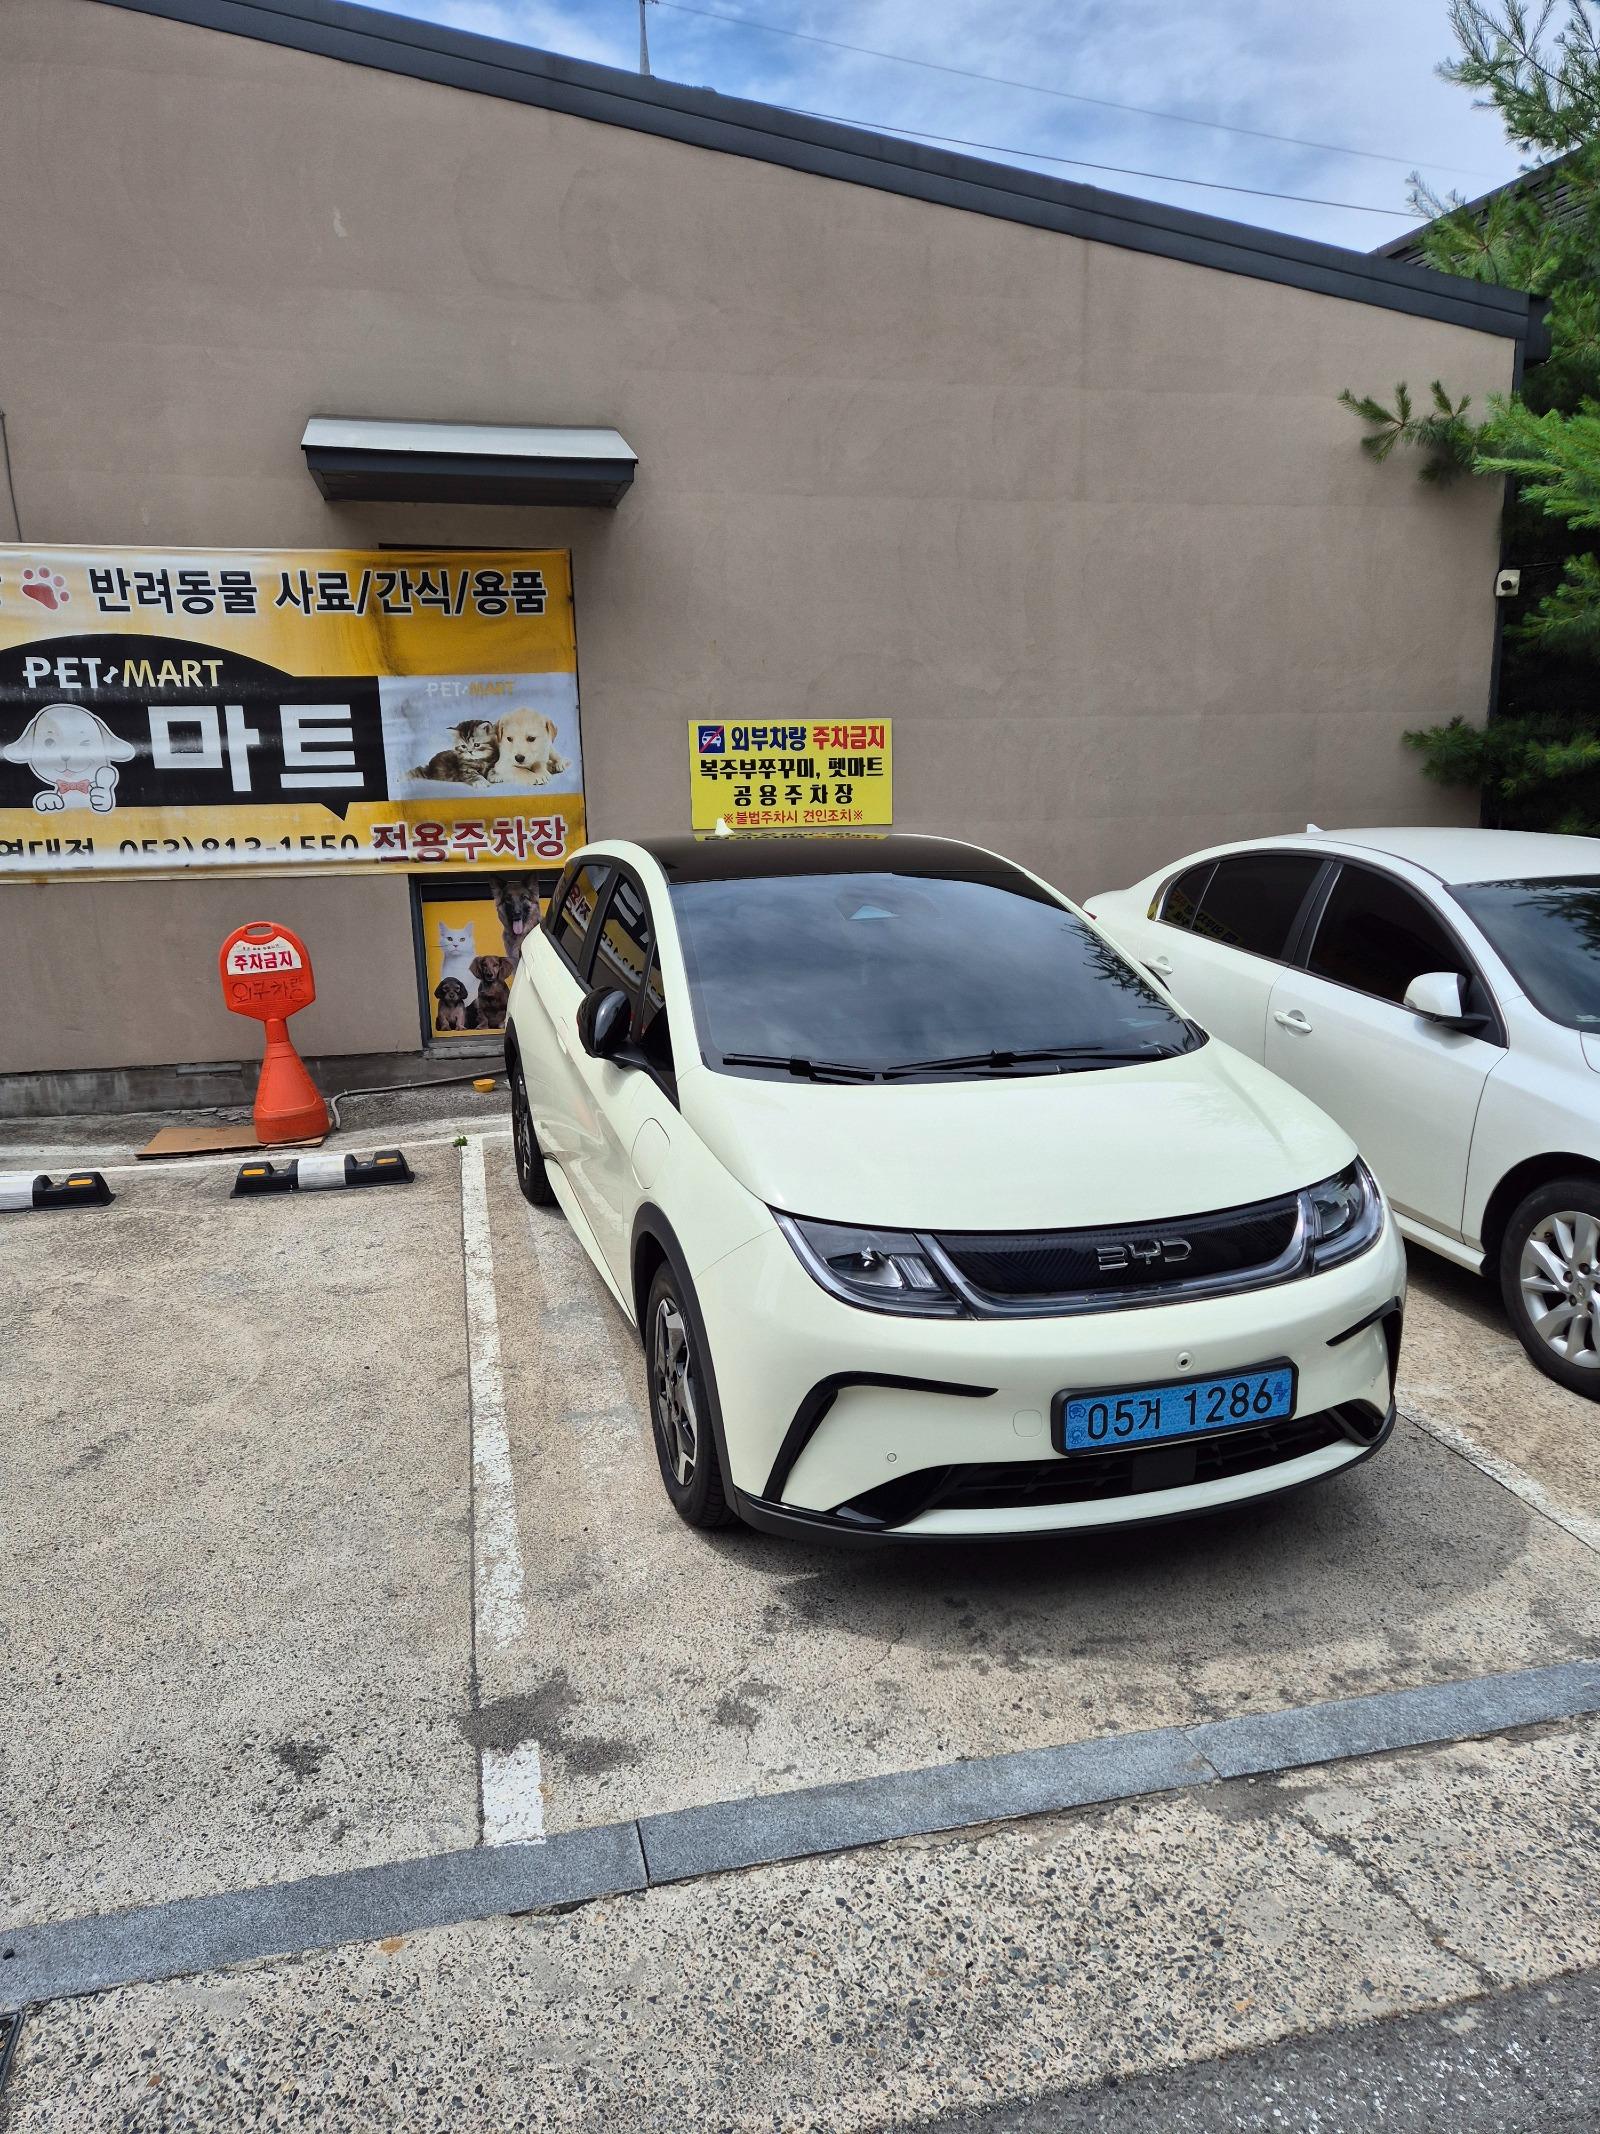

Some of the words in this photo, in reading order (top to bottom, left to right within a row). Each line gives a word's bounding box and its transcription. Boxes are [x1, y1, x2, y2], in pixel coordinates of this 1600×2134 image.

[88, 567, 259, 615] 반려동물
[274, 569, 548, 616] 사료/간식/용품
[22, 656, 101, 689] PET
[122, 659, 224, 688] MART
[147, 704, 365, 792] 마트
[731, 726, 807, 752] 외부차량
[812, 725, 885, 750] 주차금지
[828, 756, 884, 778] 펫마트
[372, 816, 566, 862] 전용주차장
[234, 950, 293, 972] 주차금지
[1096, 1237, 1192, 1271] BYD
[1087, 1397, 1161, 1440] 05거
[1184, 1378, 1273, 1426] 1286
